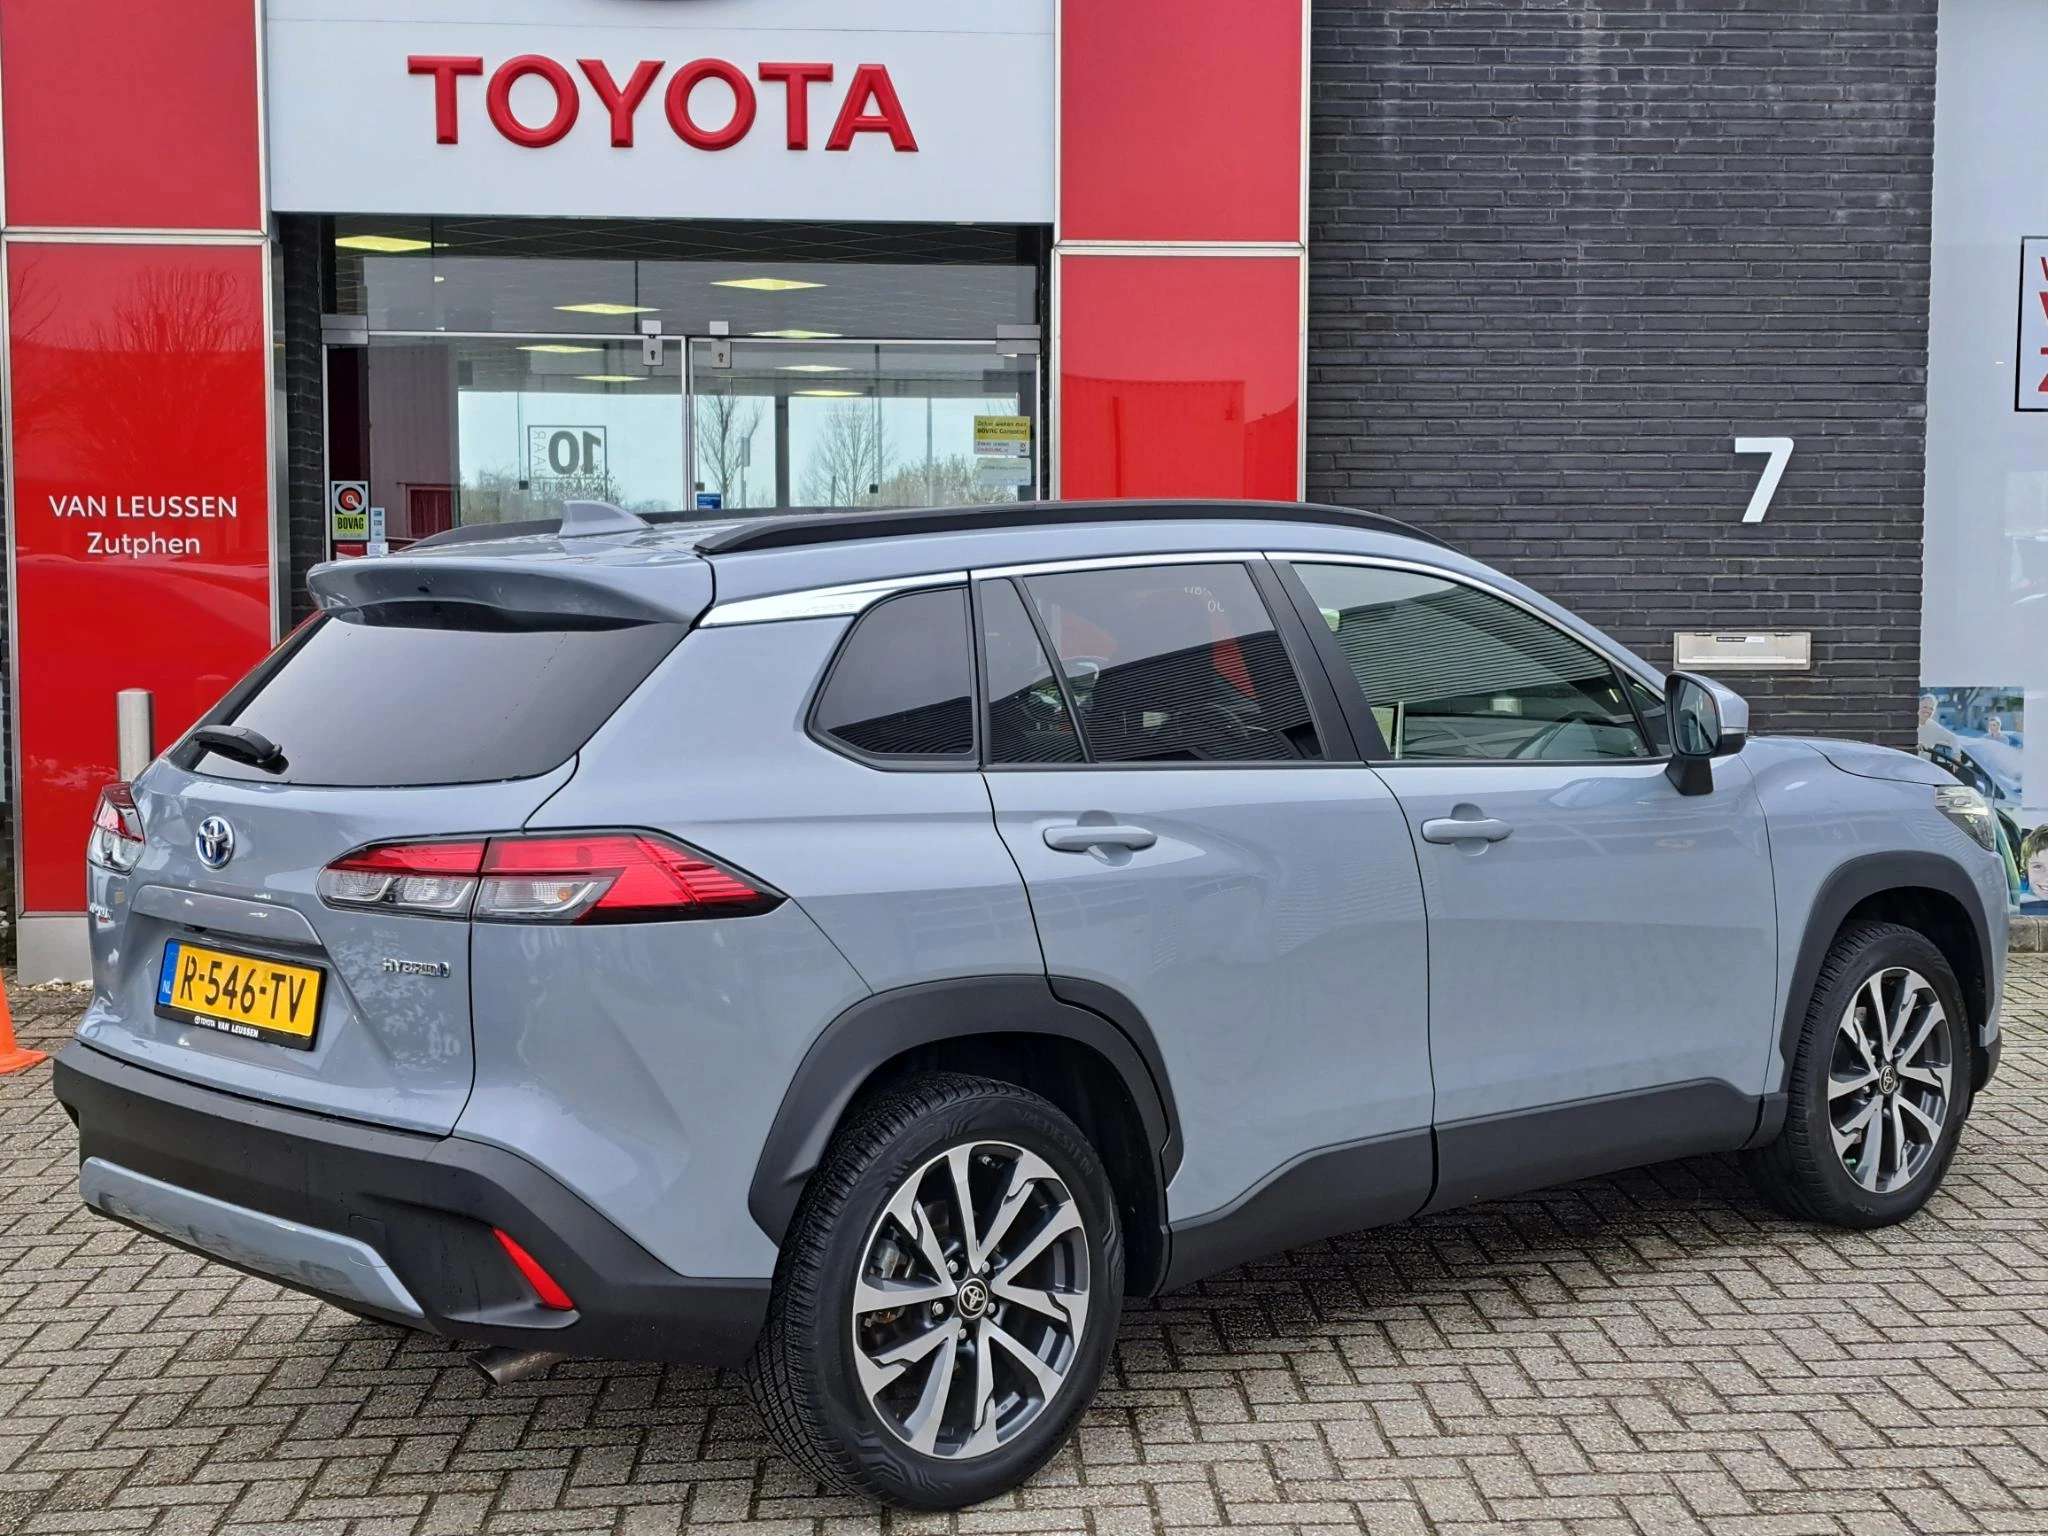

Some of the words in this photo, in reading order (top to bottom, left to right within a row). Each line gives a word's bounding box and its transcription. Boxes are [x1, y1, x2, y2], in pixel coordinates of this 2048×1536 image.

[407, 54, 919, 152] TOYOTA
[1734, 437, 1794, 523] 7
[48, 495, 107, 517] VAN
[116, 495, 237, 518] LEUSSEN
[337, 517, 364, 530] BOVAG
[87, 531, 201, 560] Zutphen
[162, 980, 171, 994] NL
[180, 955, 307, 1023] R-546-TV
[200, 1017, 215, 1028] TOYOTA
[217, 1021, 230, 1032] VAN
[231, 1023, 259, 1038] LEUSSEN
